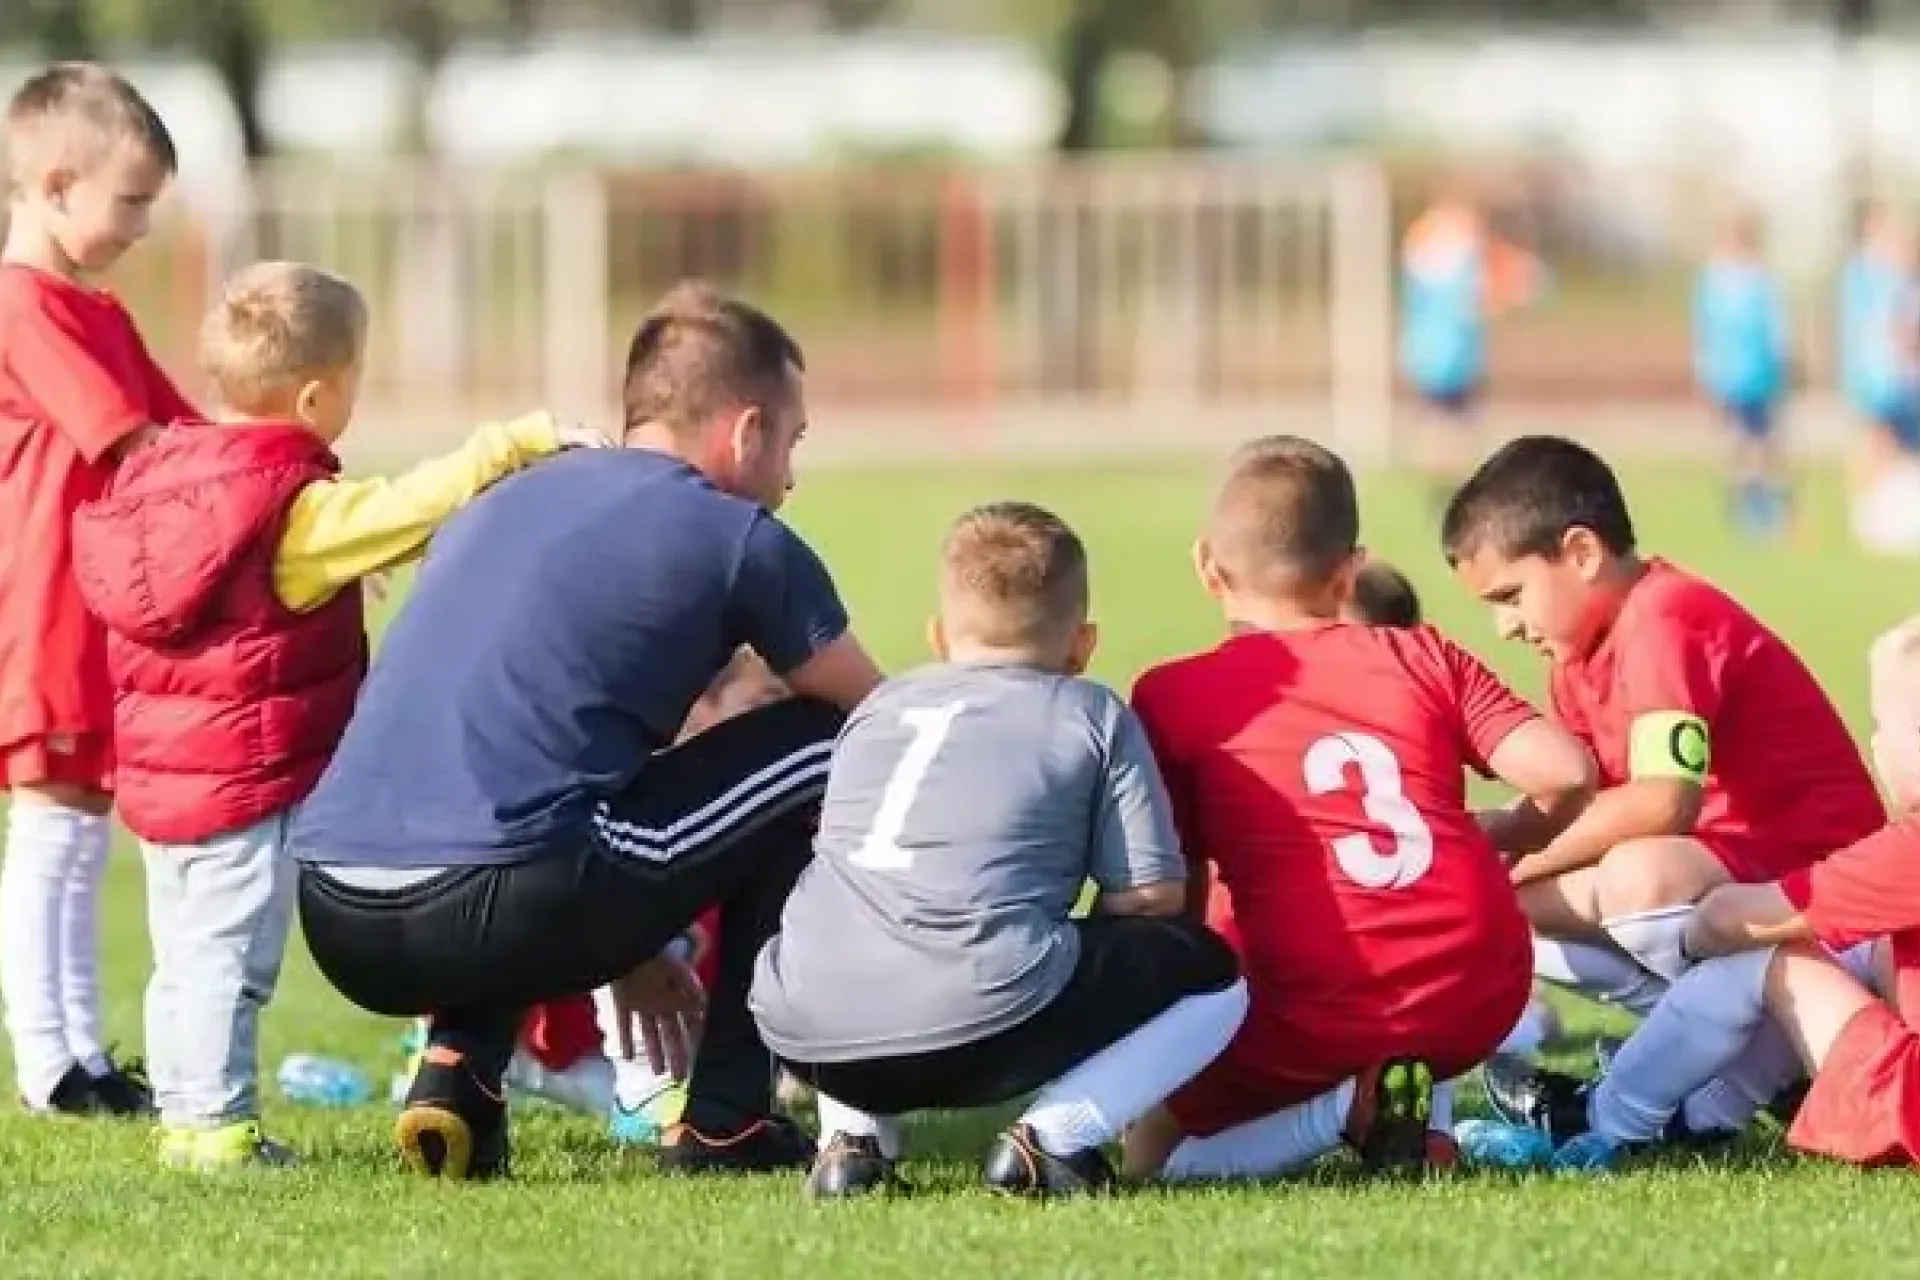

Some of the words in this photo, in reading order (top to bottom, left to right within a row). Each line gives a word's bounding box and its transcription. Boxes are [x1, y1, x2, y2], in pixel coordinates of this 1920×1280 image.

[848, 700, 965, 868] 1
[1303, 732, 1433, 889] 3
[1669, 720, 1706, 773] C
